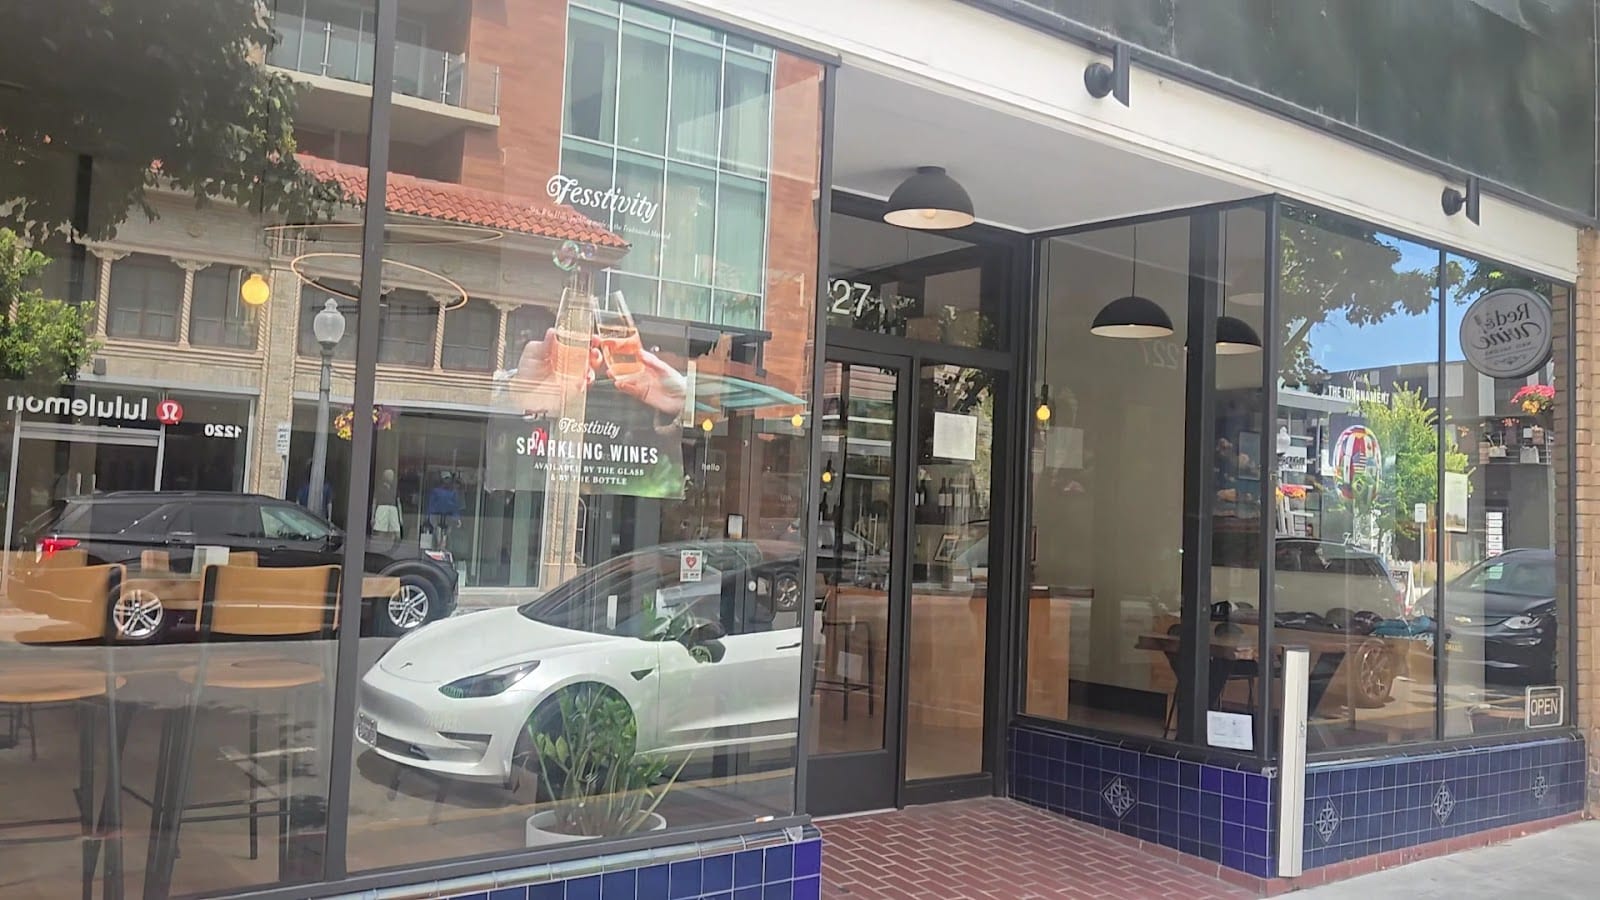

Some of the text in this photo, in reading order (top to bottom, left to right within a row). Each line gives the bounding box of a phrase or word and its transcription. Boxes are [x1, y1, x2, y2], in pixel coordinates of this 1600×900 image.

[546, 174, 659, 224] Fesstivity
[1328, 385, 1341, 399] THE
[558, 417, 621, 440] Fesstivity
[516, 436, 659, 465] SPARKLING WINES
[583, 465, 594, 474] BY
[597, 466, 615, 475] THE
[617, 468, 645, 476] GLASS
[701, 463, 721, 472] hello
[592, 476, 627, 486] BOTTLE
[1530, 697, 1559, 716] OPEN
